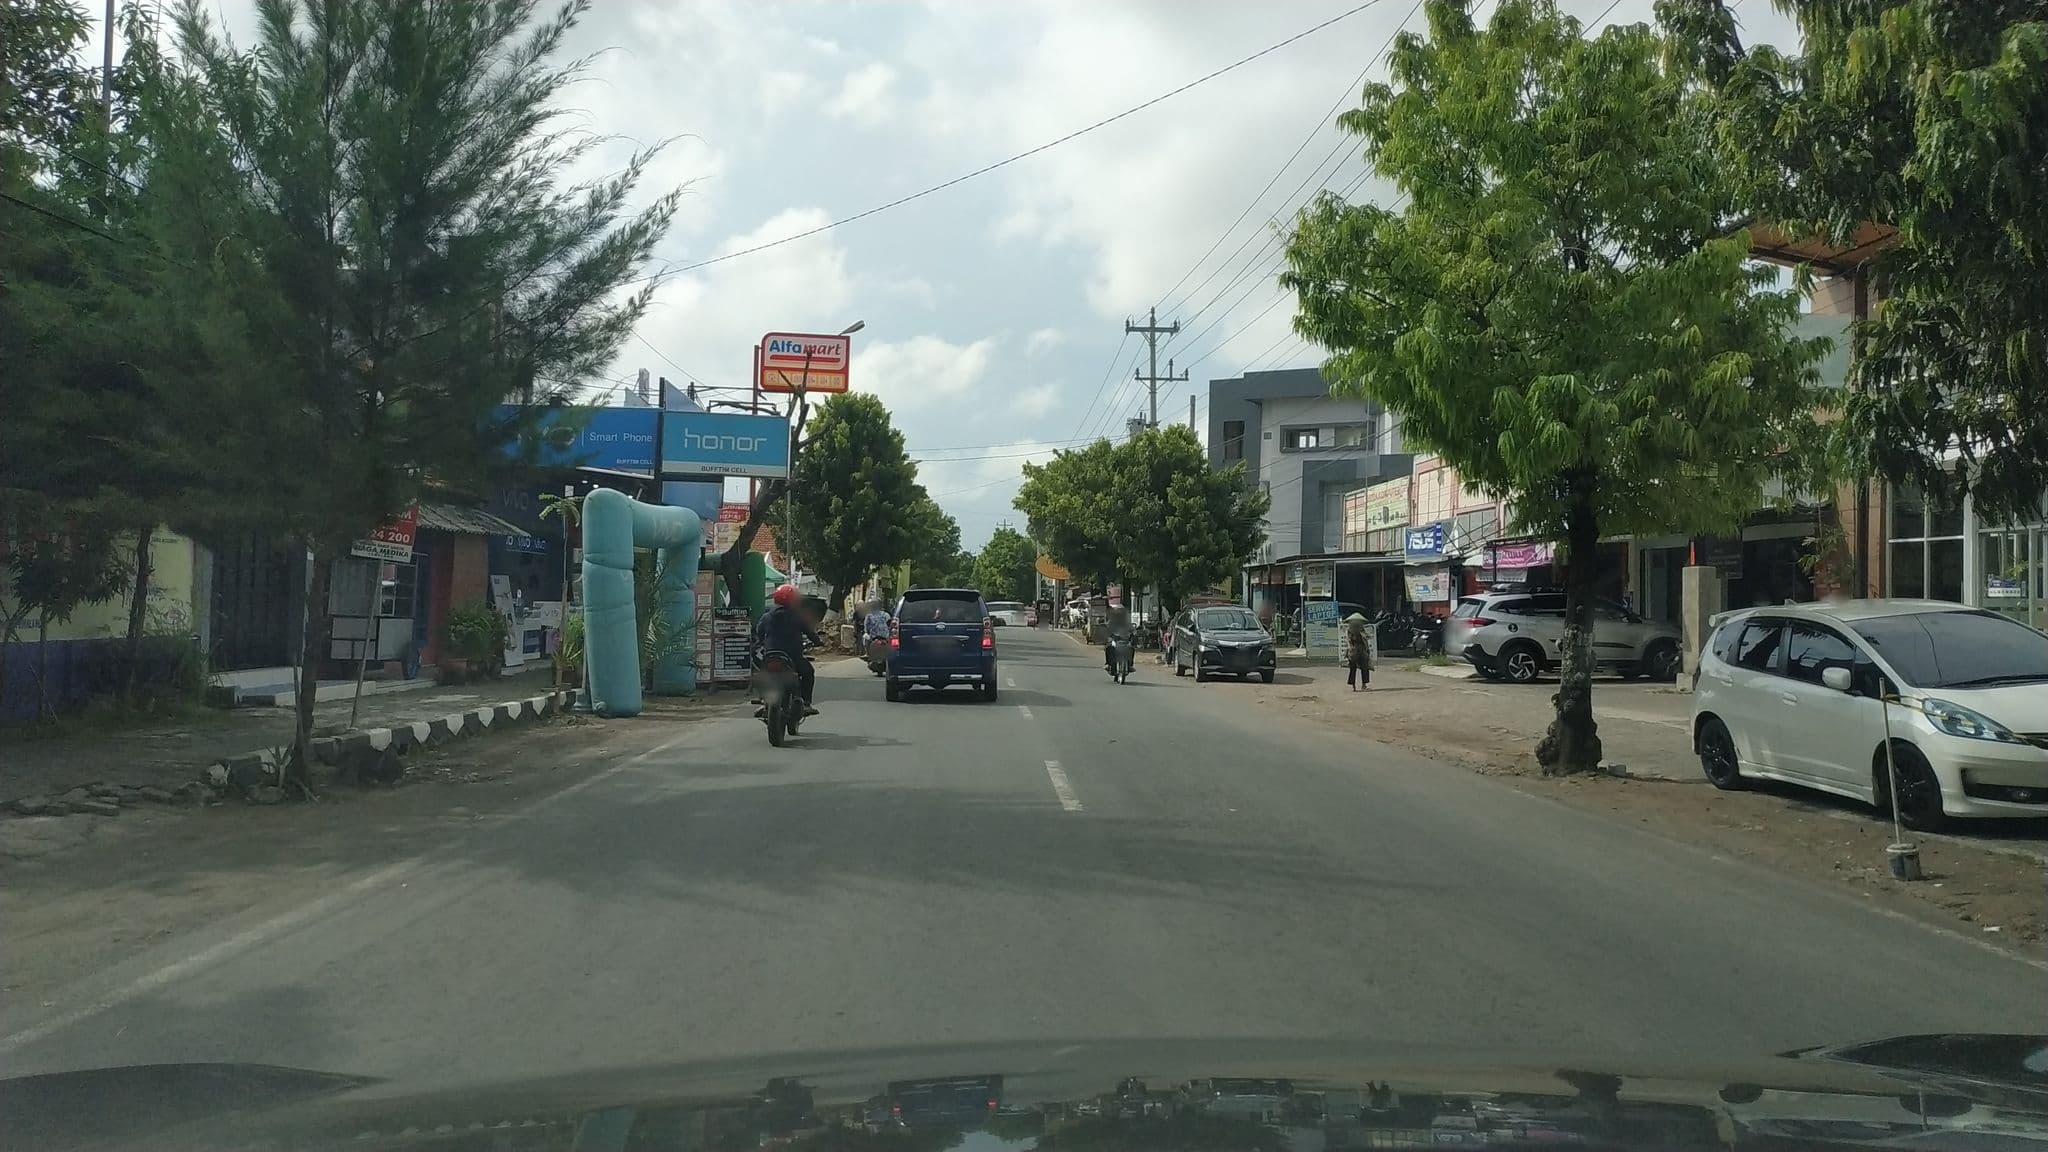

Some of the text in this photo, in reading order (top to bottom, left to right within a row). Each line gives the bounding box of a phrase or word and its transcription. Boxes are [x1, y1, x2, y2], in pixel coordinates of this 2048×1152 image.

[769, 340, 842, 356] Alfamart
[589, 432, 618, 443] Smart
[623, 432, 653, 444] Phone
[684, 427, 767, 452] honor
[730, 466, 748, 474] CELL
[387, 531, 411, 544] 200
